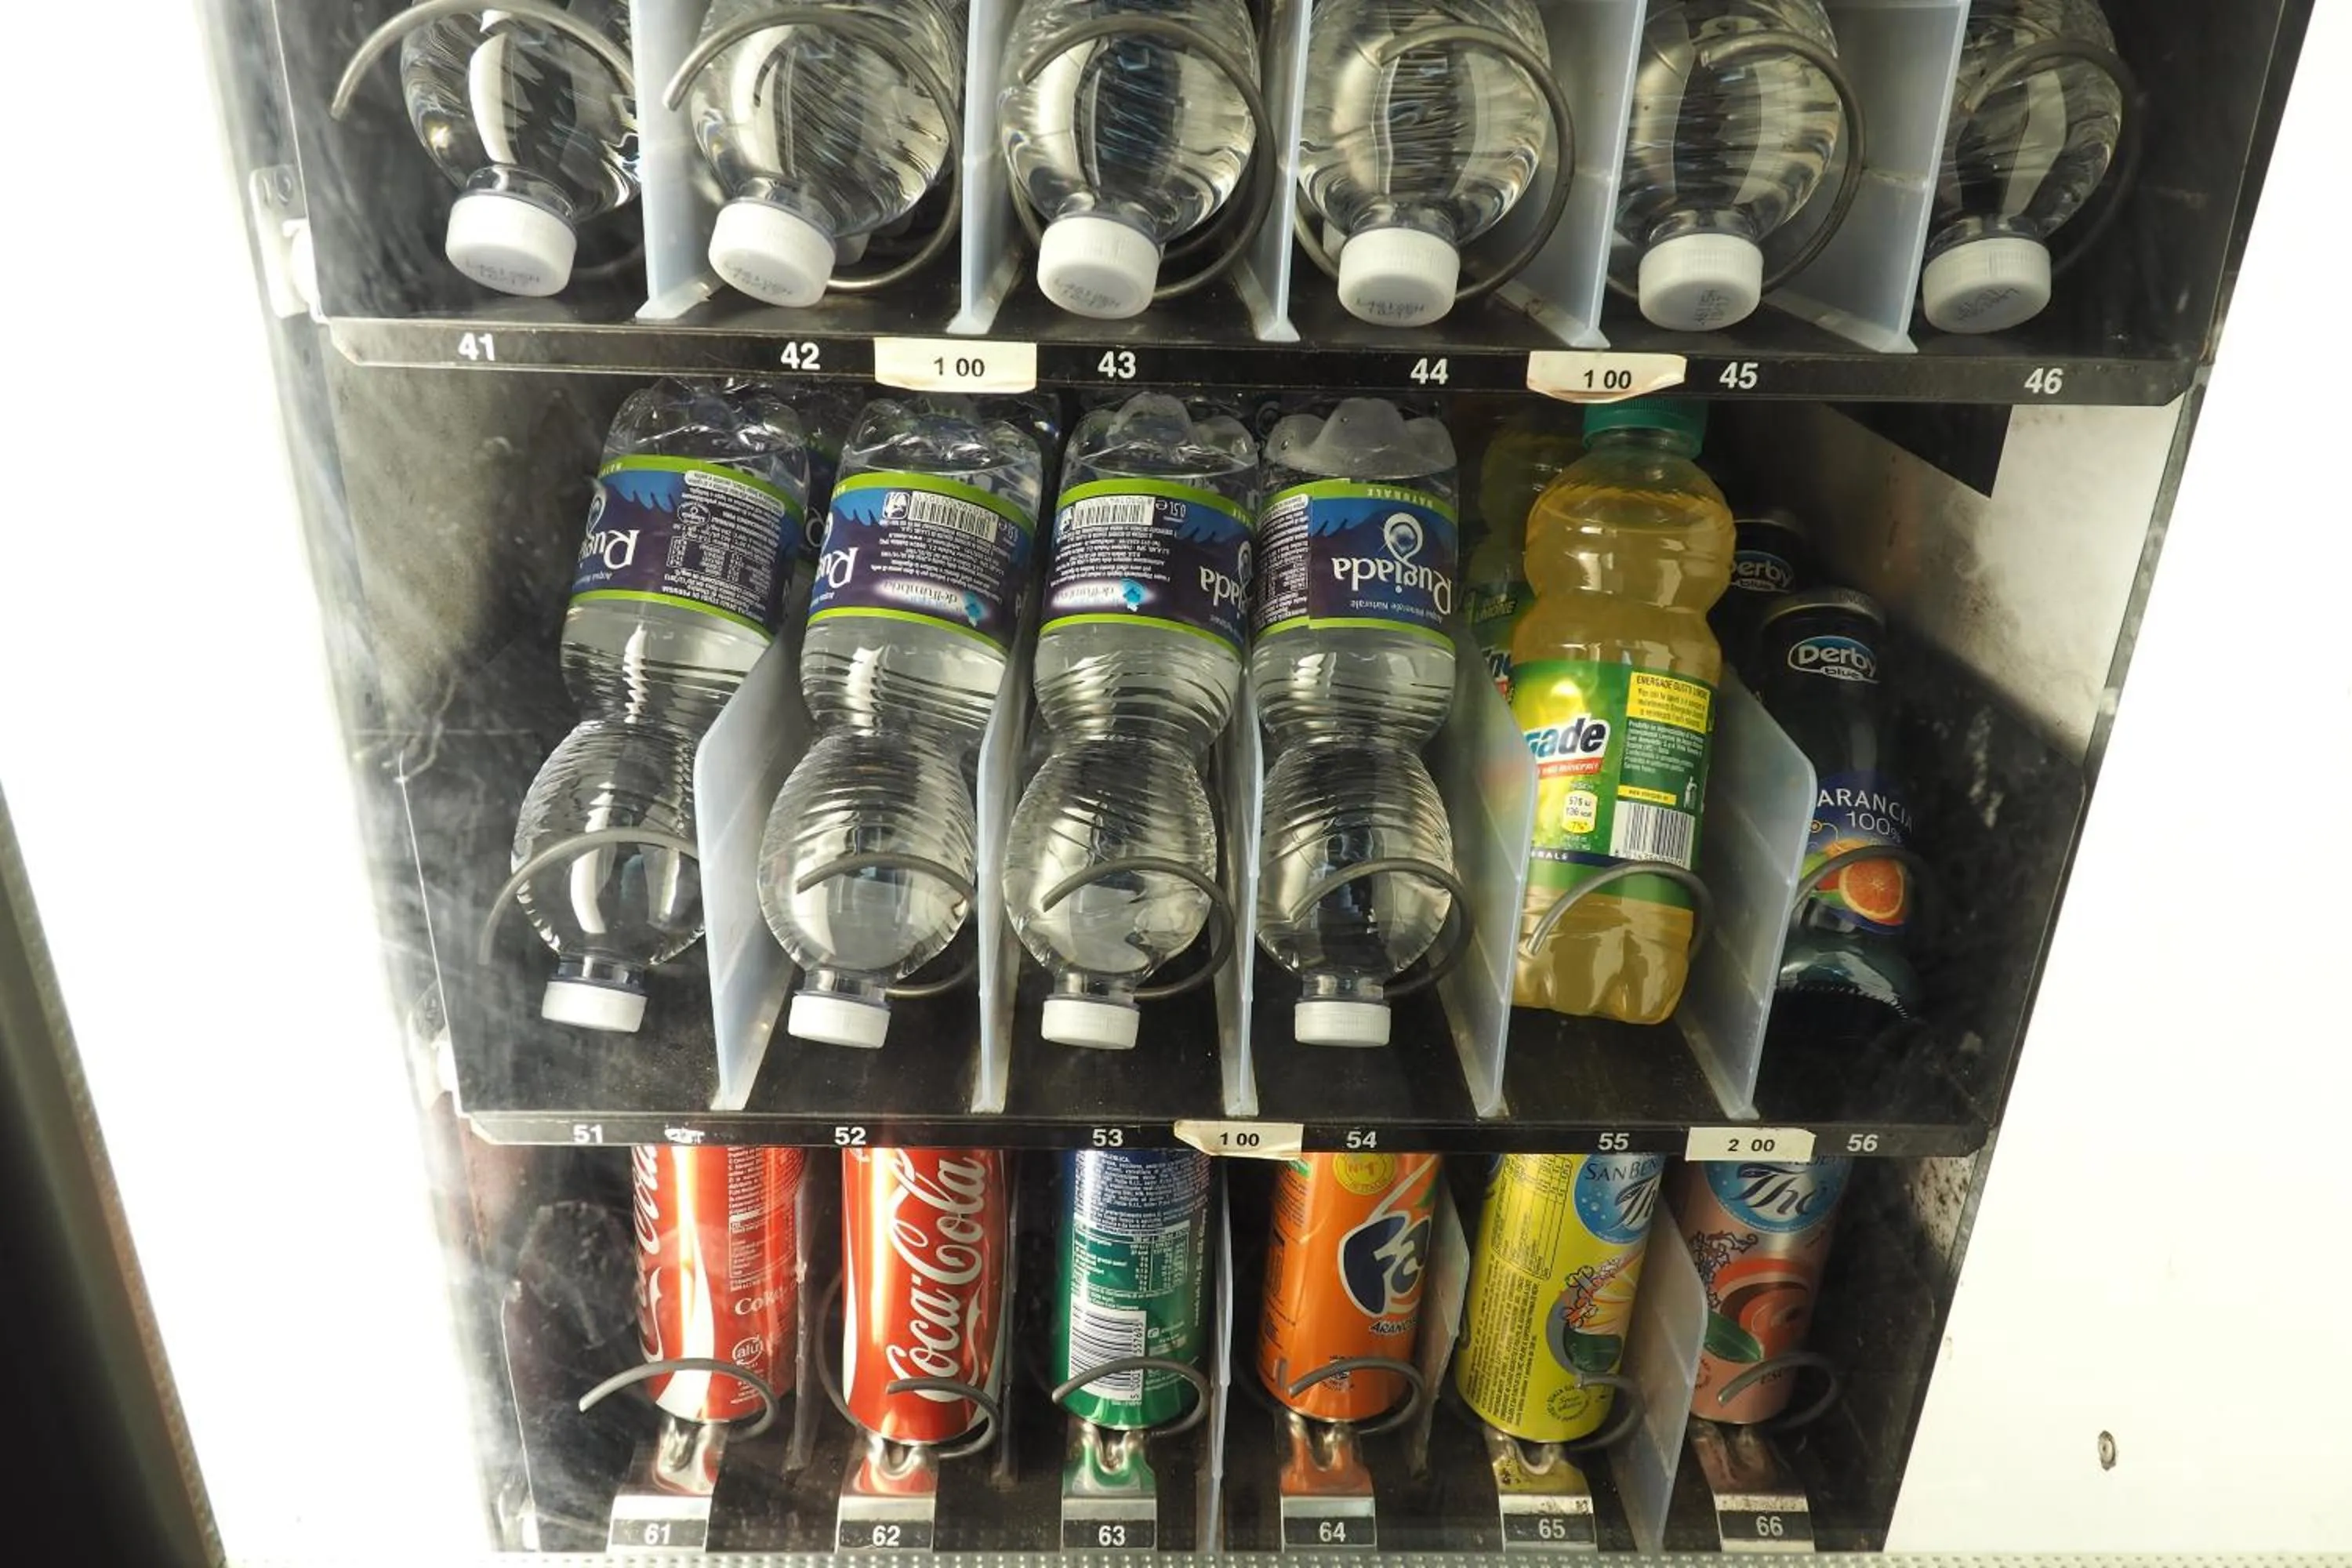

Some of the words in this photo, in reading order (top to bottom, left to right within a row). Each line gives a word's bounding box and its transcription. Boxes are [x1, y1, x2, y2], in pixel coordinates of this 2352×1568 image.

[457, 332, 495, 361] 41
[780, 342, 821, 370] 42
[933, 357, 945, 376] 1
[956, 358, 985, 377] 00
[1097, 350, 1136, 379] 43
[1410, 358, 1449, 384] 44
[1583, 369, 1593, 389] 1
[1602, 369, 1632, 390] 00
[1719, 362, 1759, 390] 45
[2024, 368, 2063, 394] 46
[1330, 513, 1452, 615] Rugiada
[1798, 644, 1876, 678] Derby
[1823, 666, 1861, 681] blue
[1845, 810, 1902, 844] 100%
[572, 1124, 604, 1144] 51
[834, 1127, 866, 1145] 52
[1092, 1128, 1123, 1147] 53
[1220, 1133, 1229, 1145] 1
[1236, 1133, 1260, 1147] 00
[1346, 1131, 1377, 1149] 54
[1597, 1133, 1629, 1151] 55
[1727, 1138, 1739, 1152] 2
[1751, 1138, 1775, 1152] 00
[1846, 1134, 1879, 1152] 56
[643, 1523, 671, 1546] 61
[872, 1524, 901, 1547] 62
[1098, 1524, 1126, 1547] 63
[1318, 1521, 1347, 1544] 64
[1537, 1519, 1566, 1540] 65
[1755, 1515, 1784, 1537] 66
